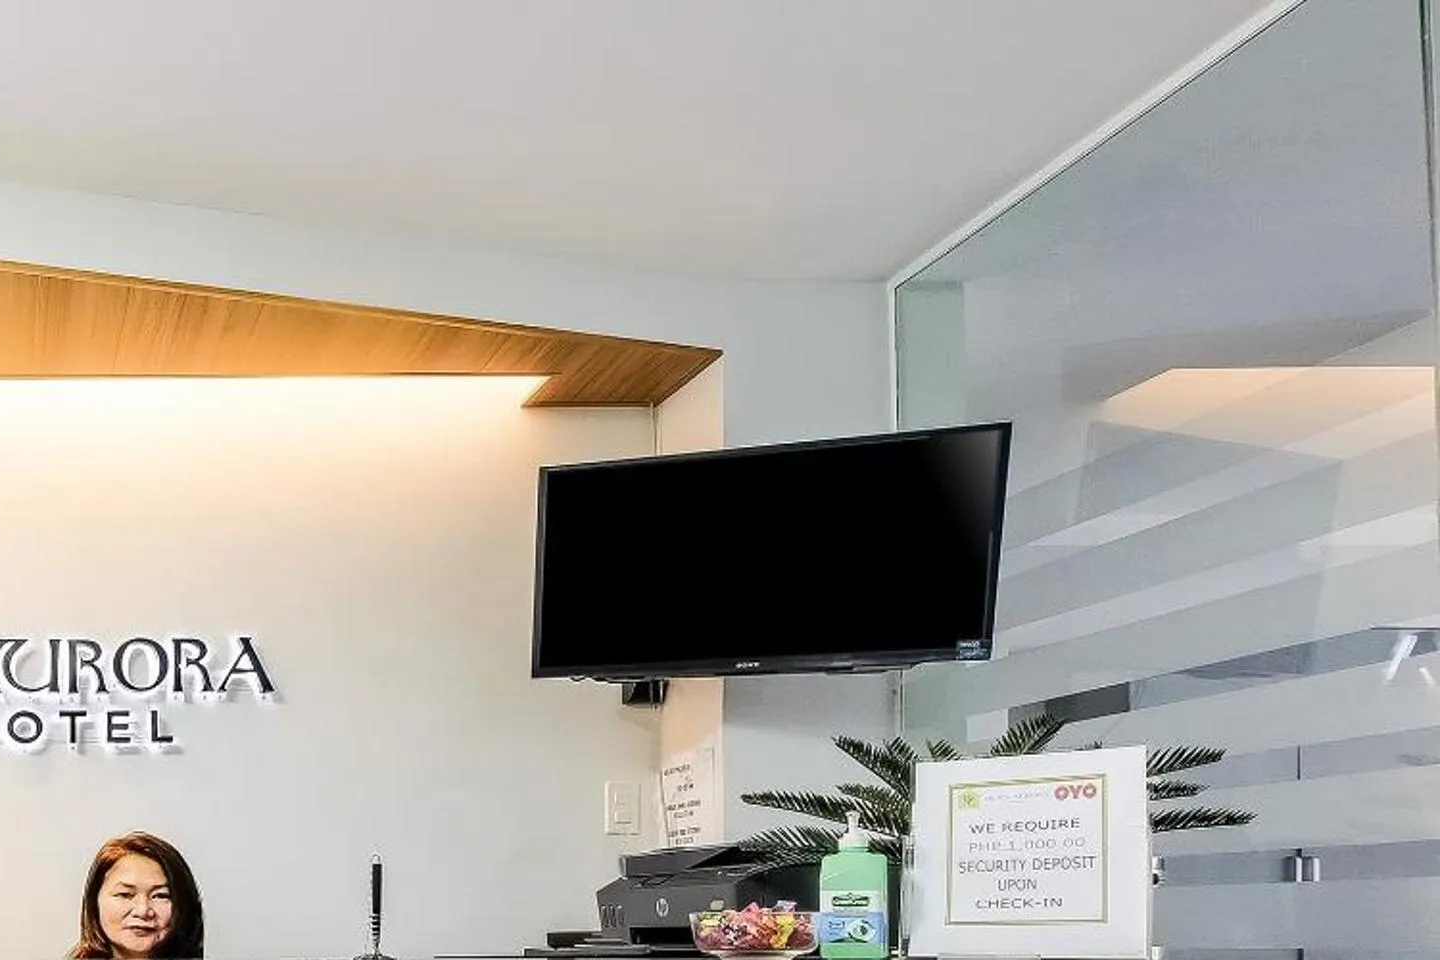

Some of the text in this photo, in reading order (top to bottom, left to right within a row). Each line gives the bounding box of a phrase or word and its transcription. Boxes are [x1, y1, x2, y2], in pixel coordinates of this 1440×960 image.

[1054, 783, 1097, 800] OYO
[969, 817, 1080, 834] WE REQUIRE
[959, 855, 1096, 874] SECURITY DEPOSIT
[997, 879, 1038, 891] UPON
[975, 898, 1063, 909] CHECK-IN
